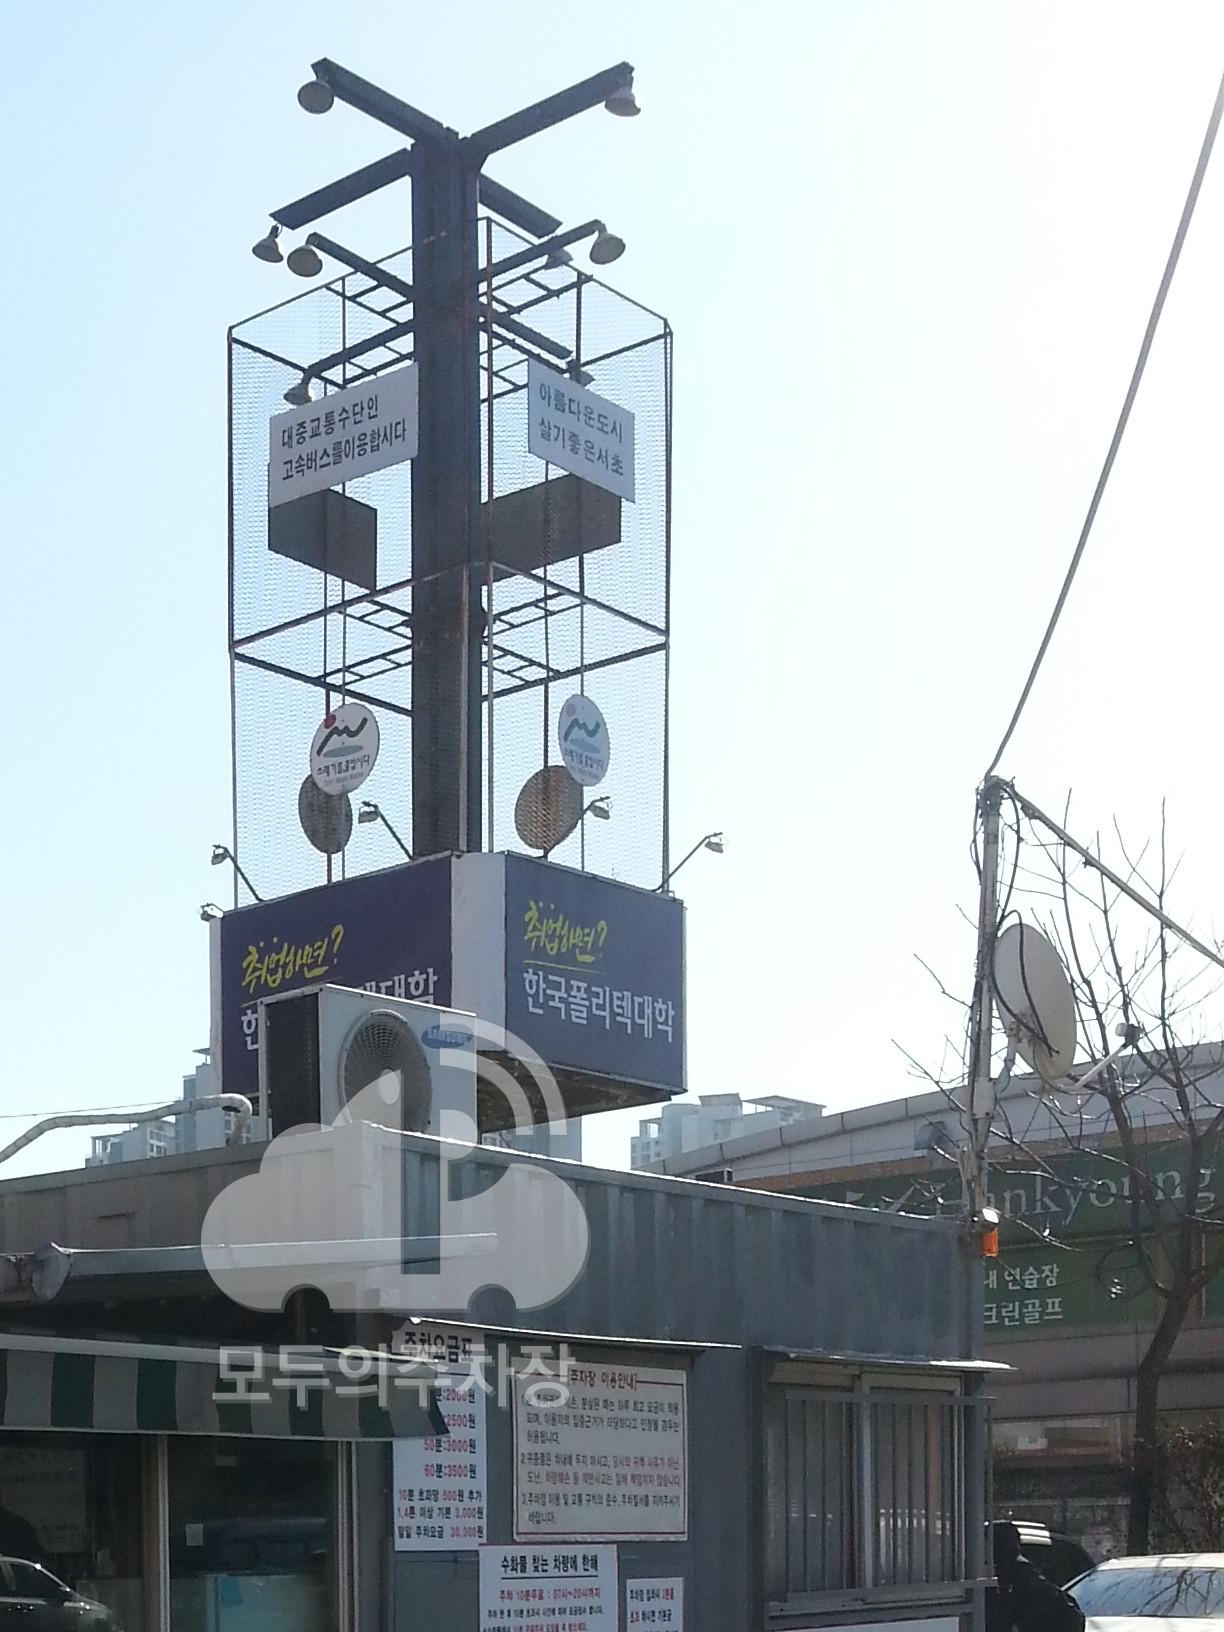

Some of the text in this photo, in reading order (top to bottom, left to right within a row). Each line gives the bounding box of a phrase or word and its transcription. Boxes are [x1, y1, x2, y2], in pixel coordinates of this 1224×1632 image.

[539, 383, 622, 443] 아름다운도시
[539, 418, 624, 476] 살기좋은서초
[523, 968, 675, 1043] 한국폴리텍대학
[1004, 1264, 1060, 1291] 연습장
[984, 1297, 1063, 1326] 크린골프
